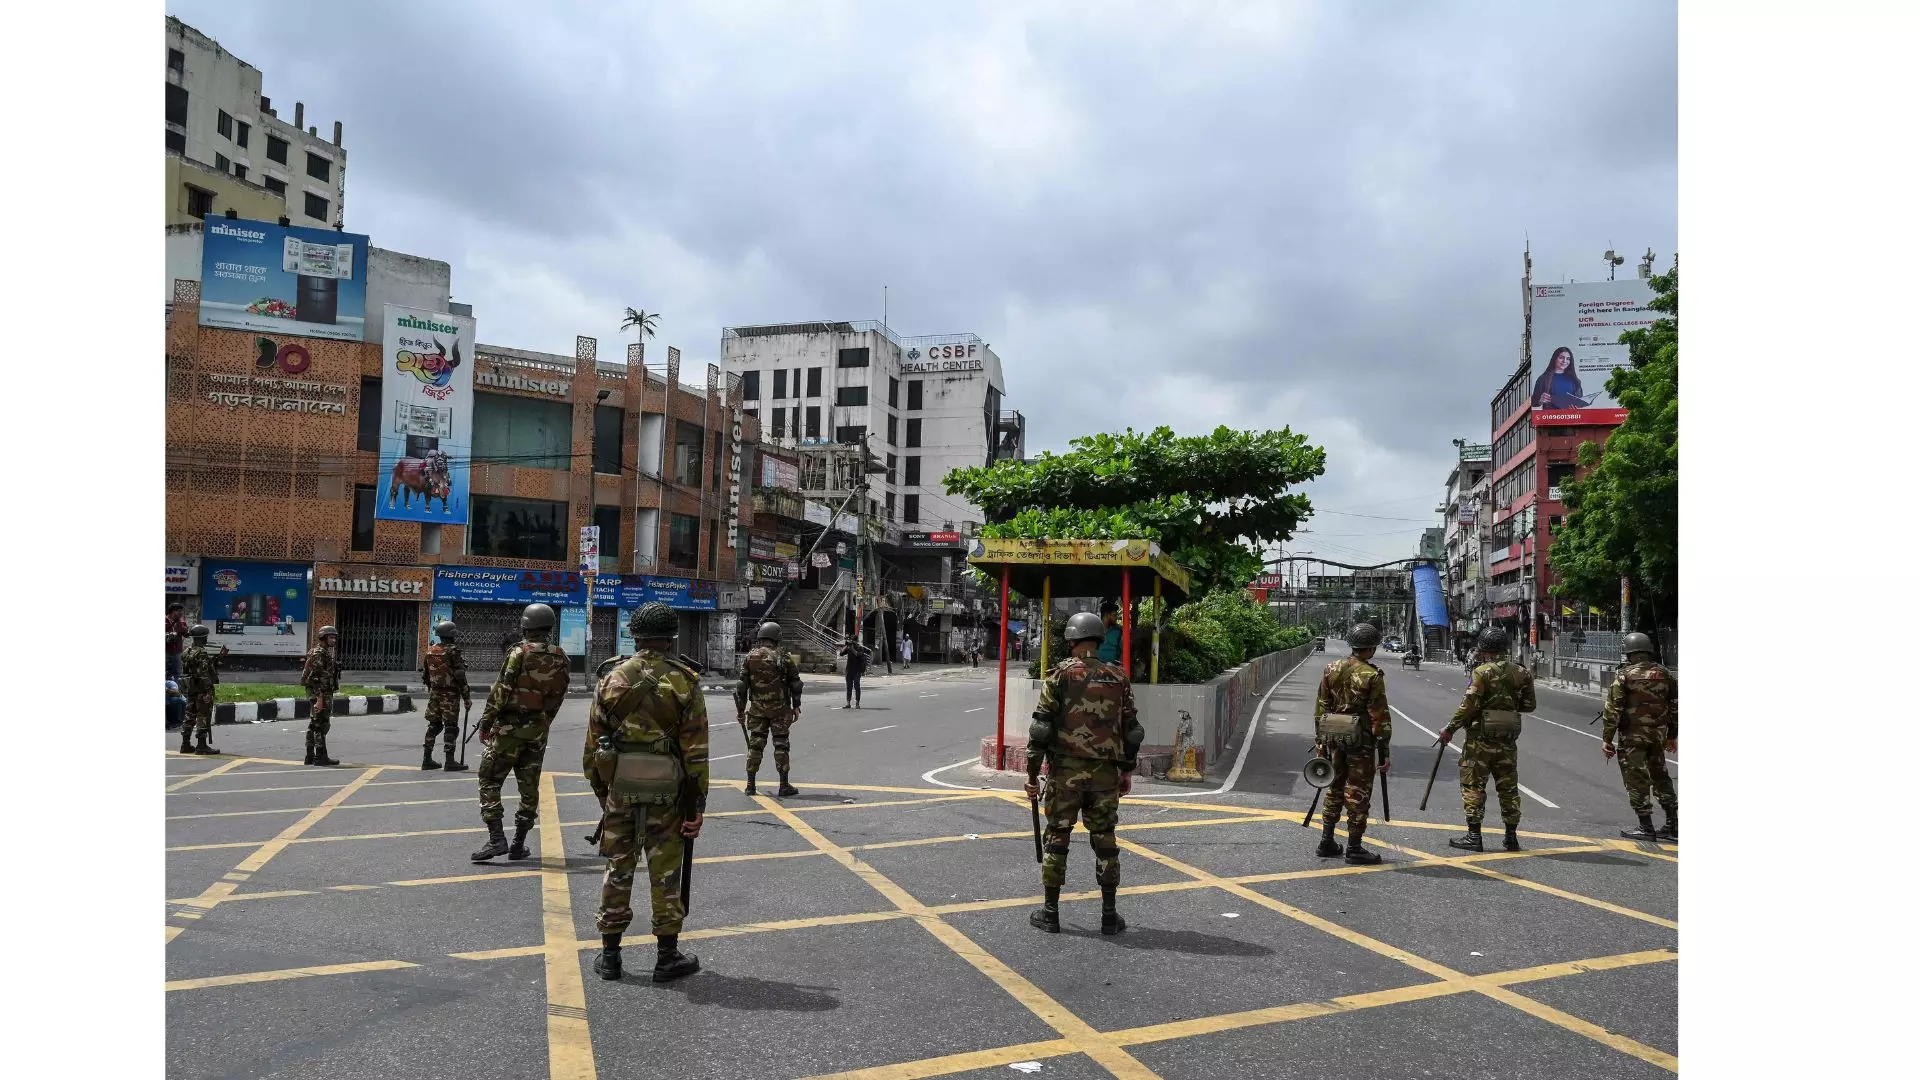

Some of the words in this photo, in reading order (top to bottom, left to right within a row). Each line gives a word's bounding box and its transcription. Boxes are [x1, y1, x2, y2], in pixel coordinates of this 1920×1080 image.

[211, 223, 266, 240] minister
[1605, 300, 1635, 308] Degrees
[397, 315, 459, 335] minister
[929, 344, 977, 360] CSBF
[900, 361, 939, 372] HEALTH
[942, 359, 982, 370] CENTER
[210, 373, 249, 386] আমার
[283, 379, 321, 393] আমার
[323, 384, 347, 395] দেশ
[422, 384, 455, 401] জিতুন
[987, 550, 1014, 560] ট্রাফিক
[1084, 550, 1117, 561] ডিএমপি
[761, 564, 783, 577] SONY
[319, 575, 424, 594] minister
[453, 580, 502, 589] SHACKLOCK
